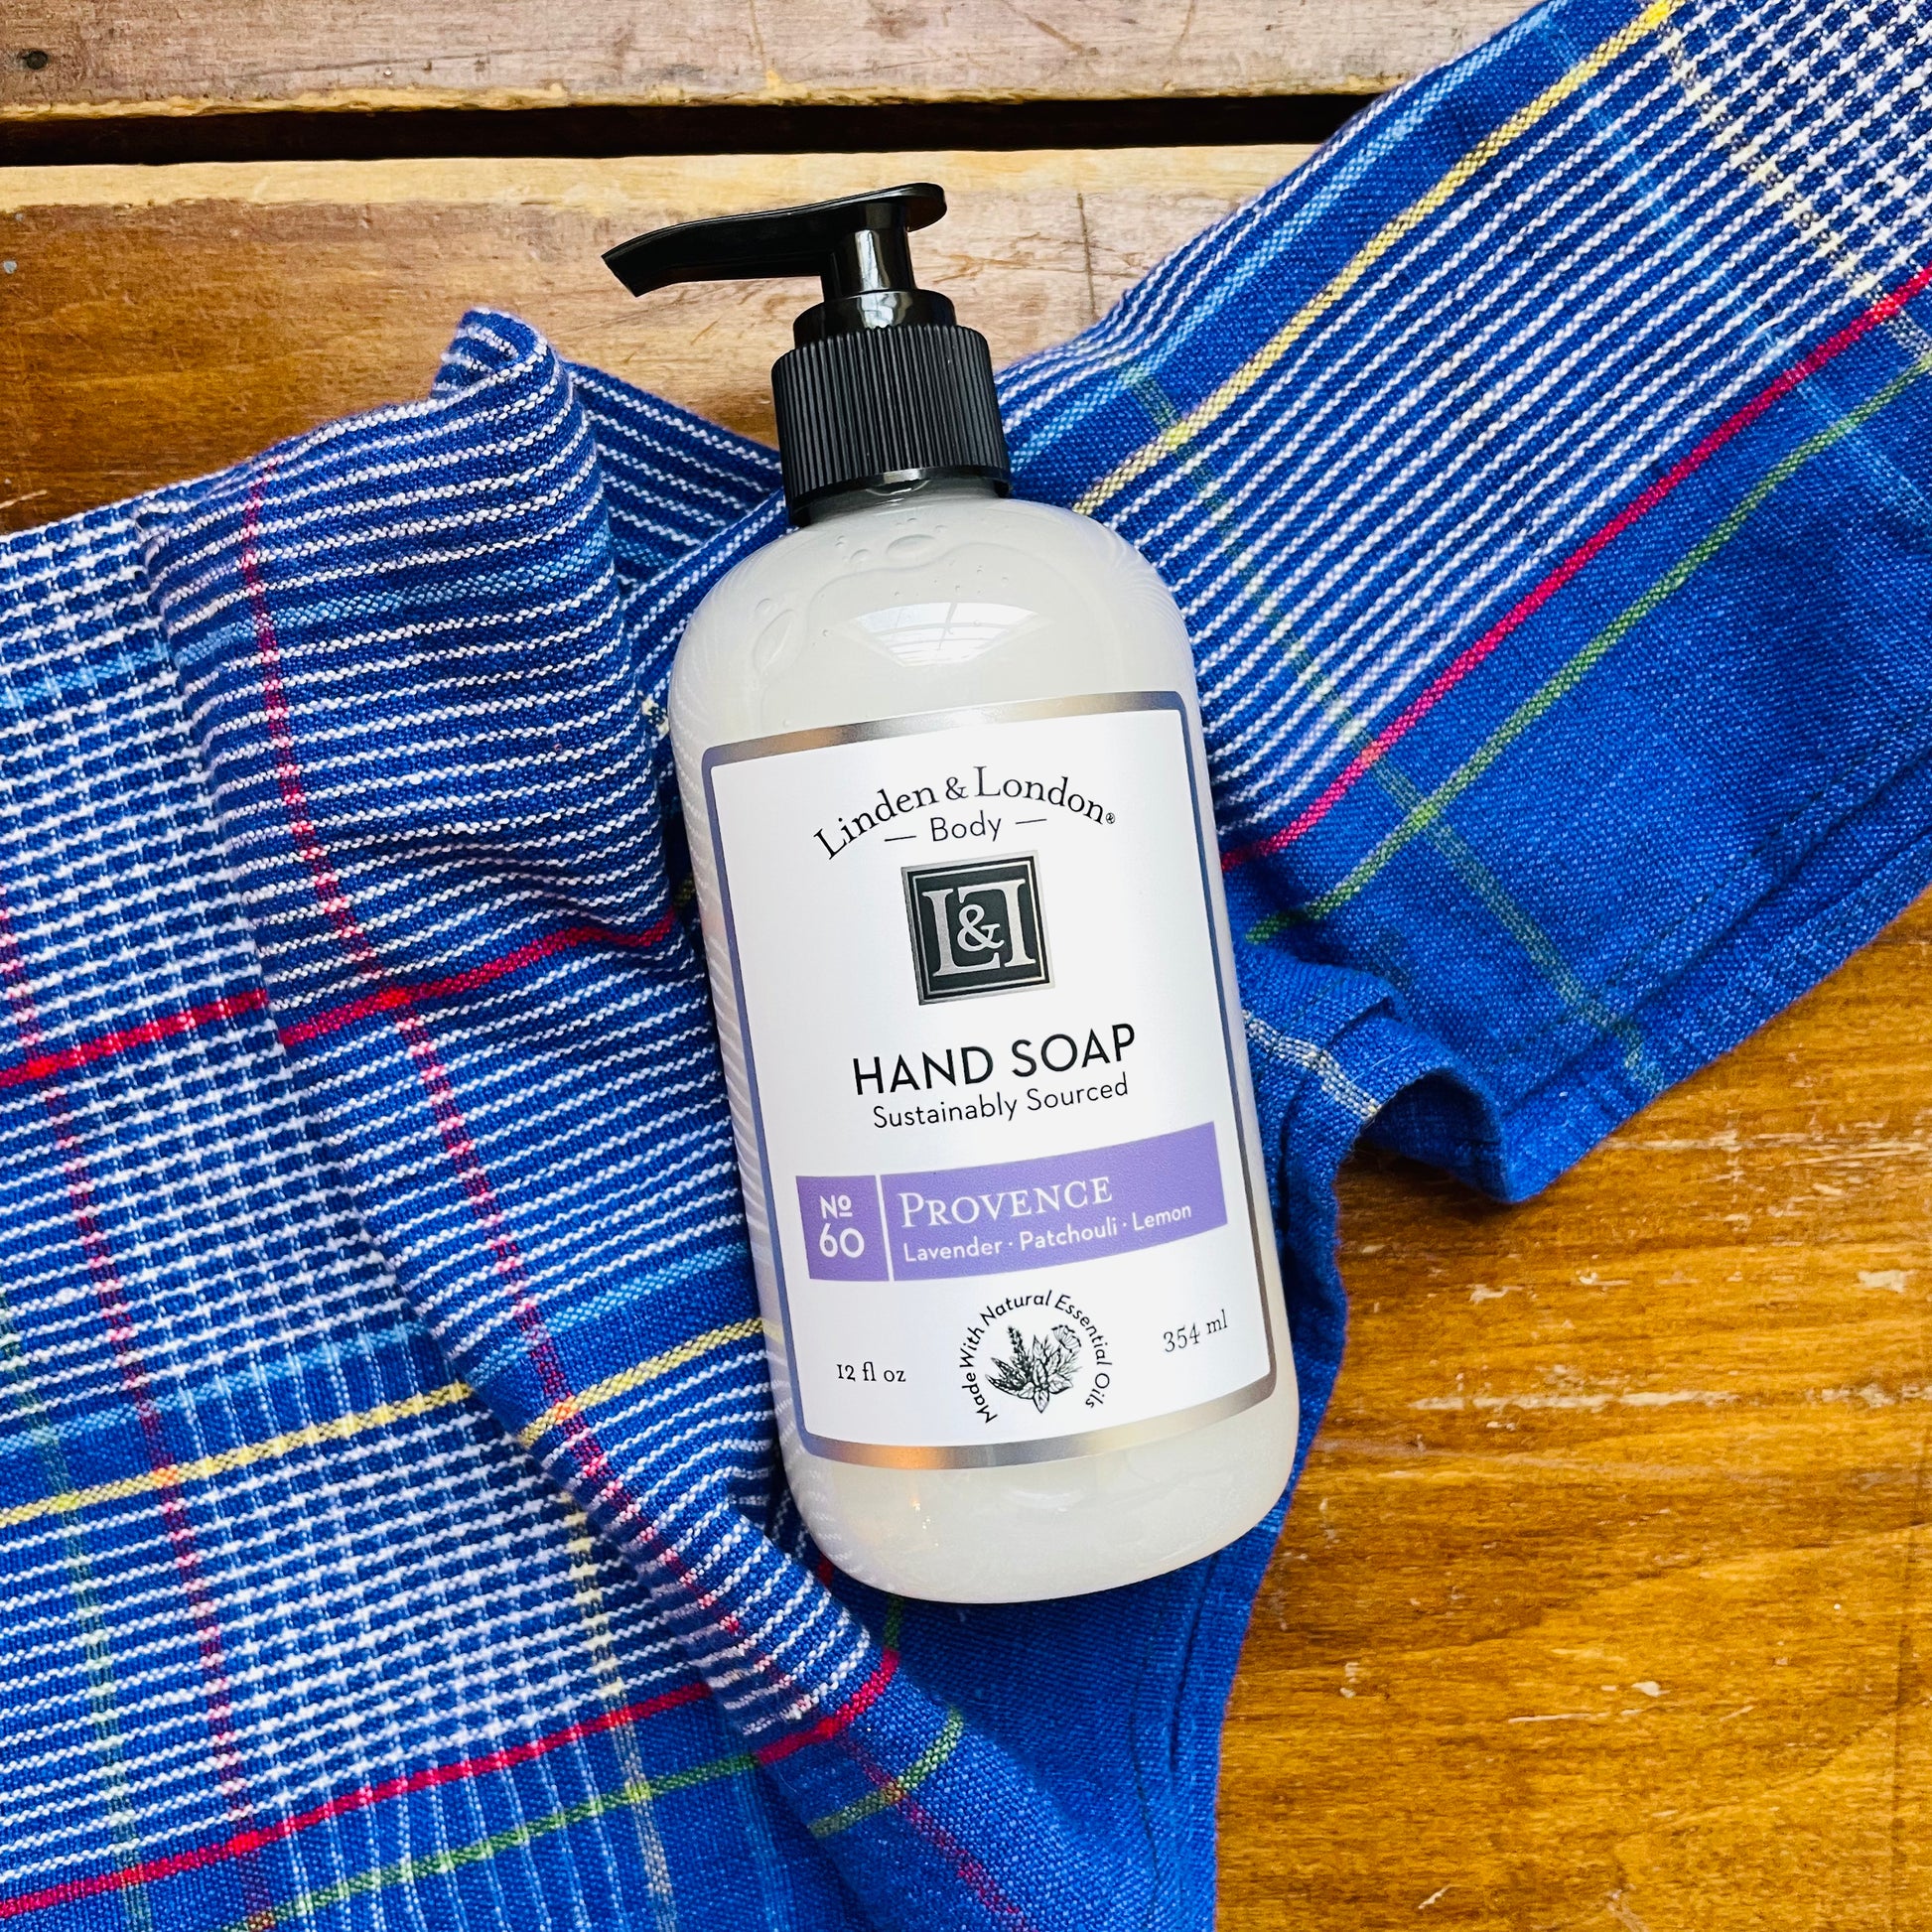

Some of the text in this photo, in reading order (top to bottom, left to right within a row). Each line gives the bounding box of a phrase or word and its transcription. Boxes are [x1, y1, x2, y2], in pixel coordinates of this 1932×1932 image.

[814, 788, 939, 860] Linden
[945, 776, 969, 800] &
[930, 810, 1002, 842] Body
[853, 1023, 1136, 1095] HAND SOAP
[873, 1071, 1129, 1129] Sustainably Sourced
[819, 1222, 865, 1259] 60
[902, 1203, 1191, 1262] Lavender Patchouli Lemon
[959, 1290, 1113, 1424] Made With Natural Essential Oils
[1163, 1309, 1229, 1353] 354 ml
[837, 1361, 906, 1383] 12 fl oz
